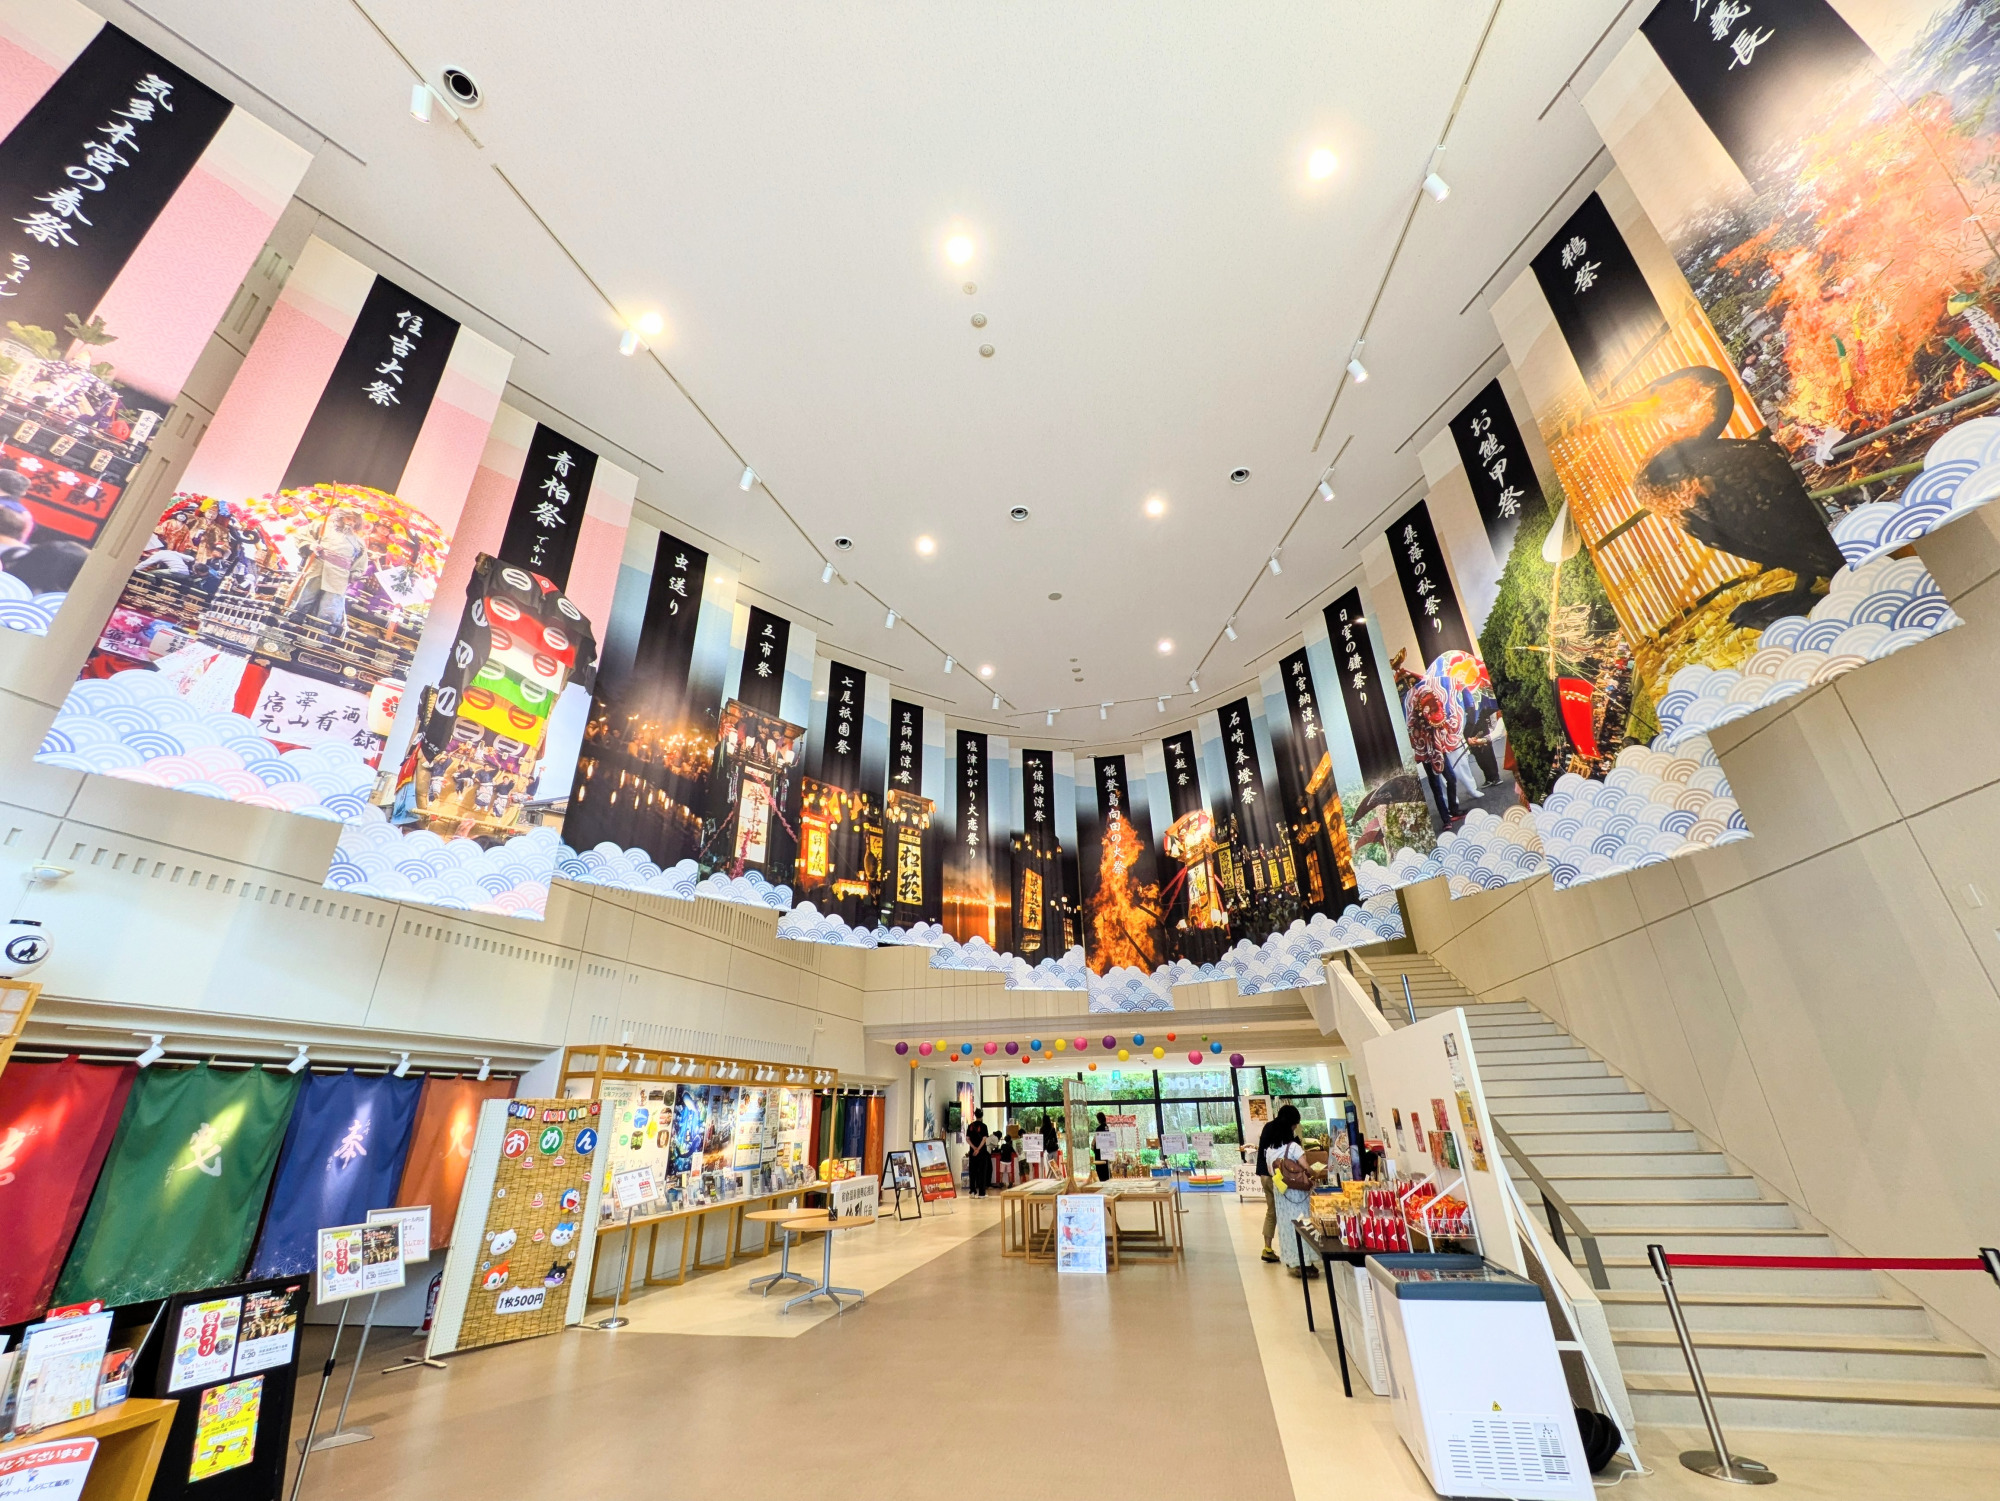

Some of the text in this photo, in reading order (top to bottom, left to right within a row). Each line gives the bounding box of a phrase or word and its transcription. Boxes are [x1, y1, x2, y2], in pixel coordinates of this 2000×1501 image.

[1561, 235, 1602, 295] 鵜祭
[362, 310, 424, 407] 住吉大祭
[529, 450, 576, 529] 青柏祭
[1470, 408, 1525, 519] お熊甲祭
[529, 534, 550, 567] でか山
[668, 552, 689, 616] 虫送り
[1403, 524, 1443, 634] 集落の秋祭り
[1339, 608, 1368, 706] 日室の鎌祭り
[257, 691, 287, 734] 宿元
[315, 709, 340, 732] 肴
[342, 705, 361, 724] 酒
[1291, 660, 1319, 740] 新宮納涼祭
[899, 711, 913, 785] 笠師納涼祭
[1228, 711, 1258, 805] 石崎奉燈祭
[965, 740, 980, 860] 塩津かがり火恋祭り
[1102, 763, 1127, 876] 能登島向田の火祭
[201, 1311, 219, 1355] 夏まつり
[498, 1292, 544, 1309] 1枚500円
